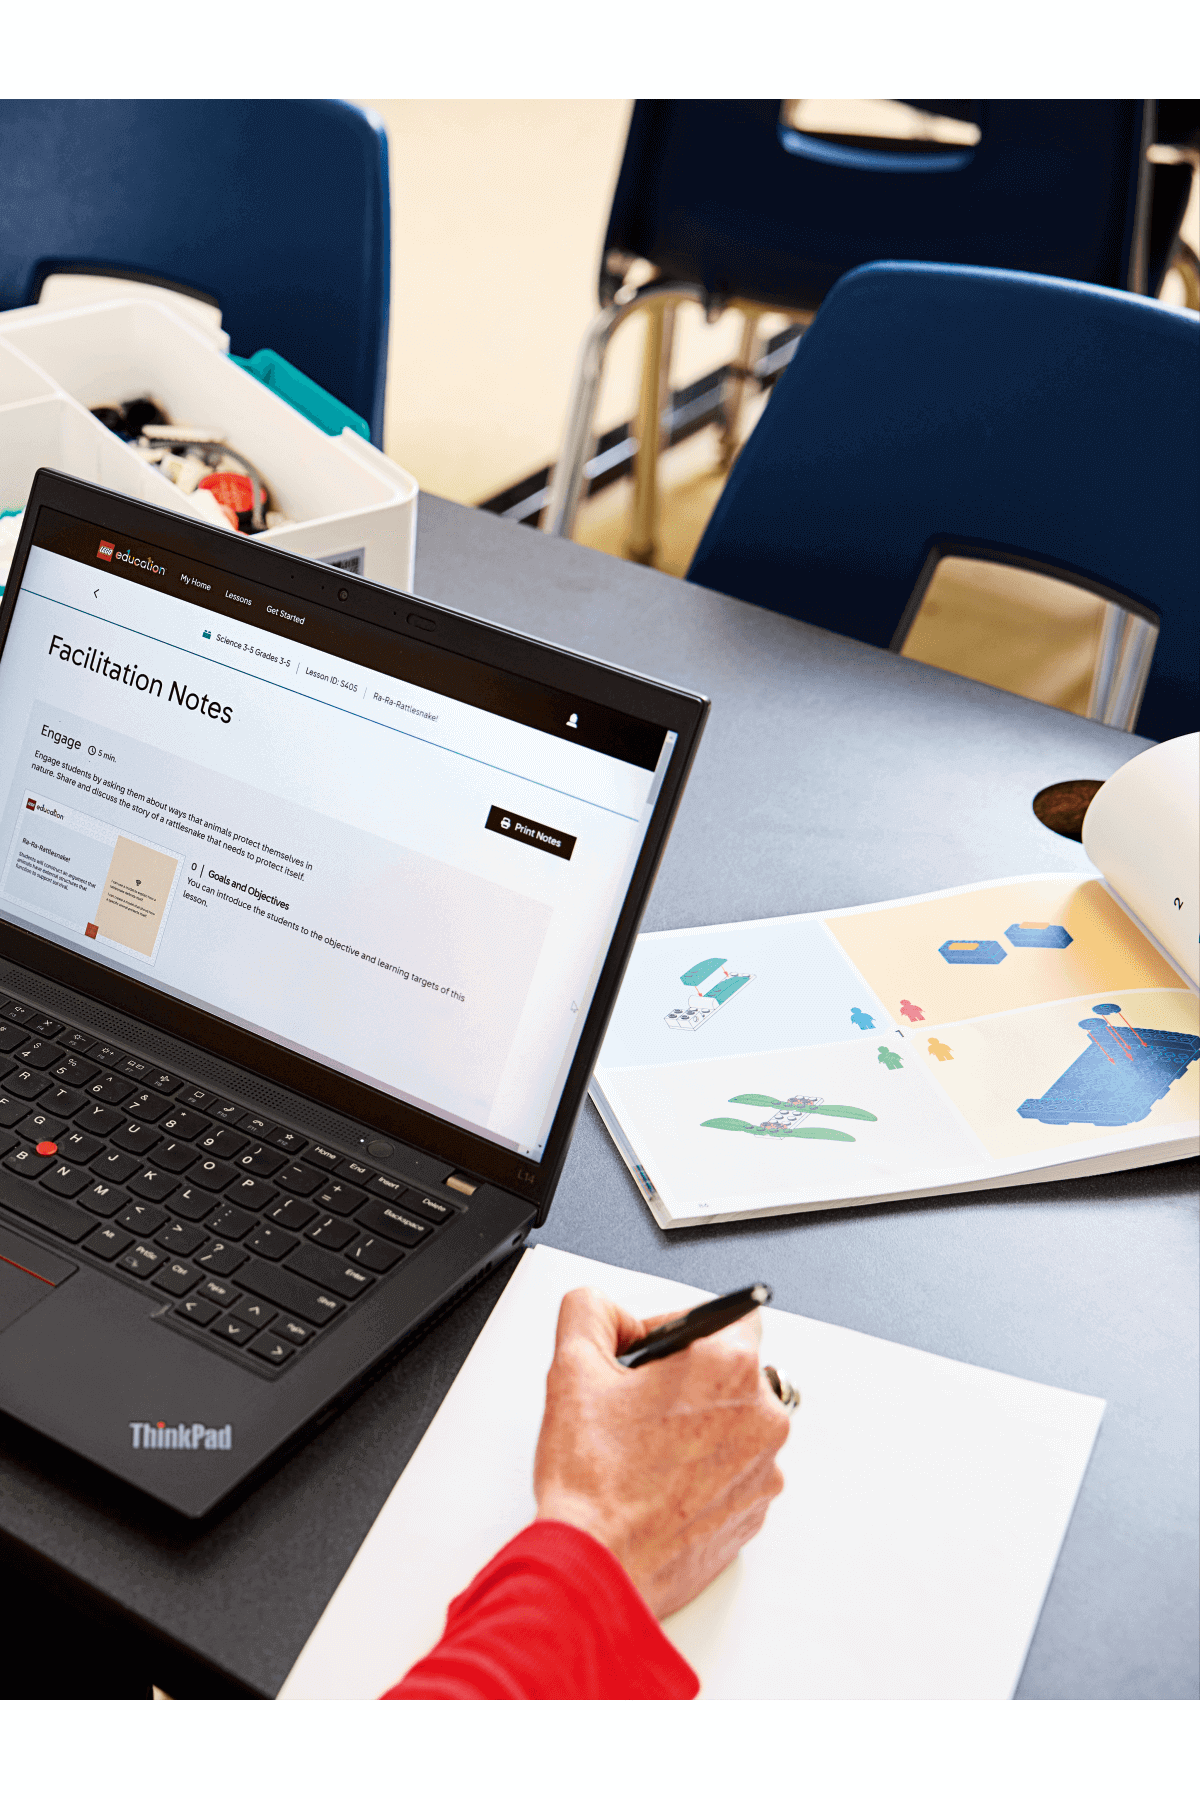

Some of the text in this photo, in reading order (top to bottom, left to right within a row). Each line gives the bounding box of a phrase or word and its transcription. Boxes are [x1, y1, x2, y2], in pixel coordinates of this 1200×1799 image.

[116, 550, 166, 576] education
[181, 574, 211, 590] My Home
[225, 590, 252, 605] Lessons
[267, 606, 305, 624] Get Started
[216, 634, 290, 667] Science 3-5 Grades 3-5
[49, 635, 233, 723] Facilitation Notes
[306, 667, 329, 681] Lesson
[330, 676, 339, 685] ID:
[41, 725, 81, 749] Engage
[103, 753, 117, 763] min.
[35, 750, 312, 870] Engage students by asking them about ways that animals protect themselves in
[32, 764, 54, 777] nature.
[56, 773, 76, 786] Share
[77, 782, 91, 792] and
[92, 788, 117, 803] discuss
[119, 799, 130, 808] the
[132, 805, 150, 818] story
[166, 819, 205, 839] rattlesnake
[207, 835, 222, 846] that
[223, 843, 245, 856] needs
[247, 852, 254, 860] to
[255, 857, 283, 872] protect
[285, 867, 304, 881] itself.
[515, 823, 561, 847] Print Notes
[209, 870, 230, 885] Goals
[231, 881, 247, 892] and
[248, 887, 289, 910] Objectives
[183, 890, 207, 907] lesson.
[1173, 897, 1184, 910] 2
[188, 877, 200, 889] You
[202, 885, 215, 895] can
[217, 889, 251, 910] introduce
[254, 906, 265, 916] the
[267, 913, 299, 931] students
[311, 931, 323, 941] the
[324, 938, 359, 956] objective
[361, 953, 376, 963] and
[378, 958, 409, 980] learning
[412, 974, 439, 990] targets
[451, 991, 465, 1002] this
[34, 1116, 45, 1124] G
[70, 1134, 82, 1142] H
[16, 1151, 28, 1159] B
[315, 1147, 336, 1159] Home
[57, 1167, 70, 1176] N
[144, 1171, 157, 1180] K
[350, 1163, 365, 1173] End
[94, 1185, 109, 1195] M
[379, 1177, 399, 1189] Insert
[183, 1190, 191, 1198] L
[423, 1198, 446, 1211] Delete
[384, 1209, 424, 1230] Backspace
[129, 1421, 232, 1450] ThinkPad
